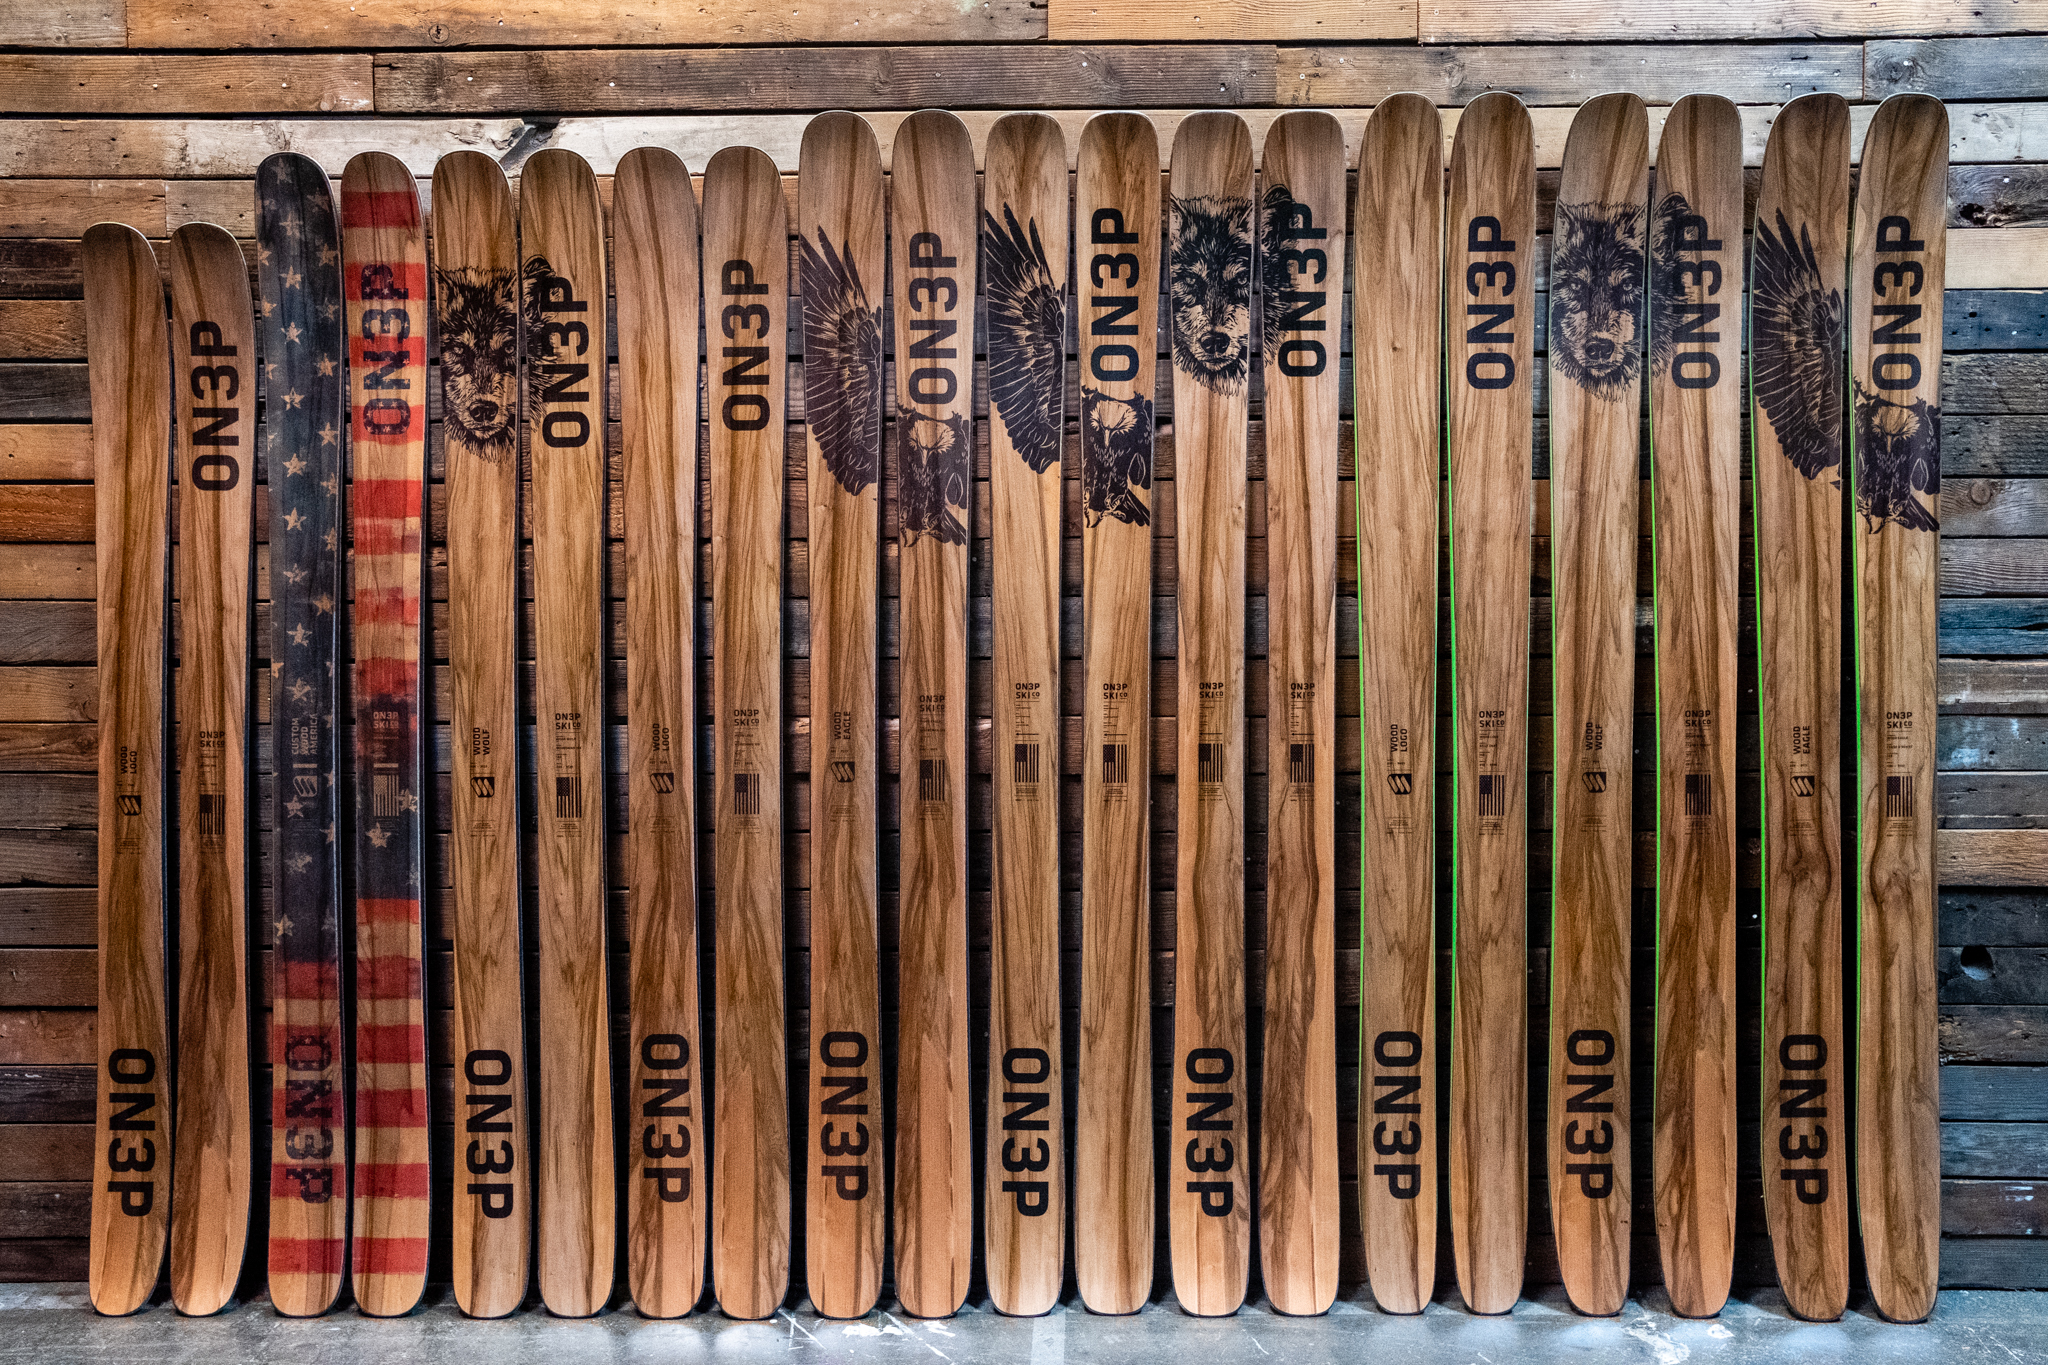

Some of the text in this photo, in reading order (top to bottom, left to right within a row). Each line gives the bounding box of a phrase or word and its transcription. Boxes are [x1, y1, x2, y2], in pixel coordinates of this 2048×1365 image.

[361, 264, 411, 436] ON3P
[542, 275, 590, 448] ON3P
[721, 259, 770, 431] ON3P
[909, 231, 958, 405] ON3P
[1090, 207, 1140, 382] ON3P
[1277, 201, 1327, 377] ON3P
[1466, 215, 1517, 390] ON3P
[1671, 214, 1723, 390] ON3P
[1872, 215, 1925, 391] ON3P
[190, 320, 240, 492] ON3P
[473, 727, 481, 755] WOOD
[482, 729, 490, 755] WOLF
[652, 723, 660, 751] WOOD
[734, 709, 759, 717] ON3P
[734, 718, 749, 726] SKI
[834, 712, 842, 740] WOOD
[920, 704, 934, 712] SKI
[1802, 725, 1810, 754] EAGLE
[108, 1048, 156, 1217] ON3P
[284, 1034, 333, 1204] ON3P
[465, 1048, 514, 1219] ON3P
[641, 1033, 691, 1202] ON3P
[820, 1031, 868, 1201] ON3P
[1002, 1047, 1050, 1217] ON3P
[1186, 1047, 1234, 1217] ON3P
[1373, 1031, 1422, 1200] ON3P
[1566, 1029, 1614, 1199] ON3P
[1779, 1034, 1828, 1205] ON3P
